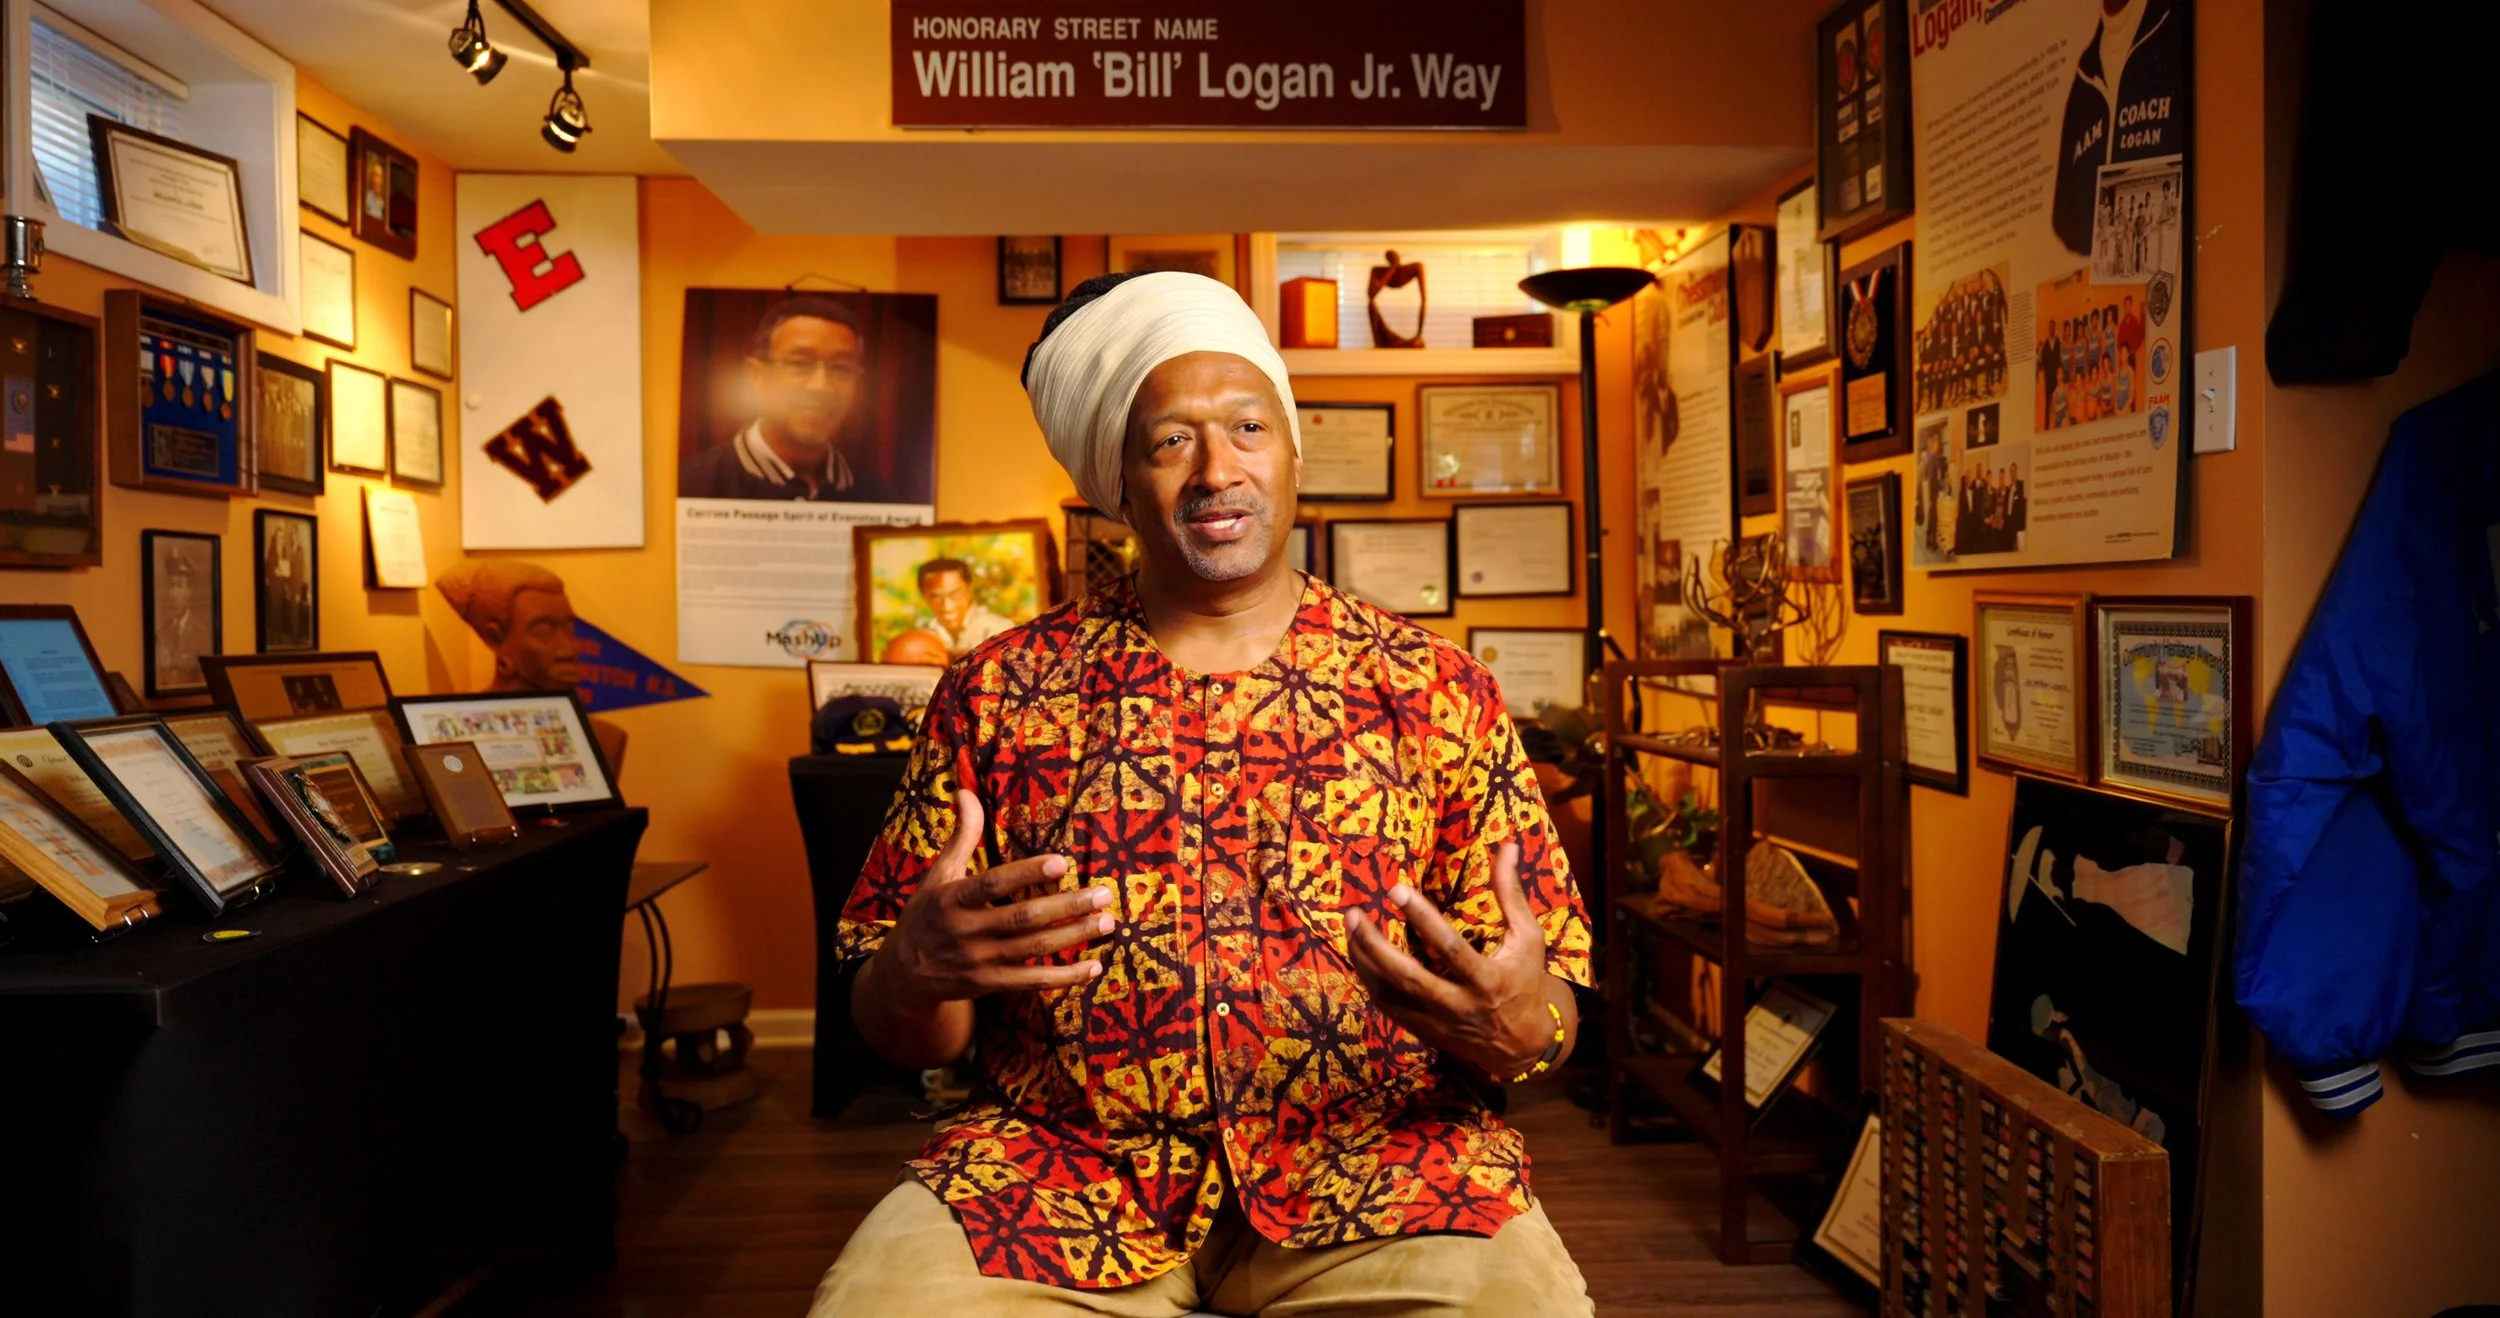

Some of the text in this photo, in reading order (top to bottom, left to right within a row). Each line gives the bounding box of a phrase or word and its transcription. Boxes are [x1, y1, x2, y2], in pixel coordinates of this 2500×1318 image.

[913, 17, 1218, 40] HONORARY STREET NAME
[912, 50, 1075, 98] William
[1199, 52, 1334, 110] Logan
[1351, 53, 1401, 99] Jr.
[1411, 53, 1502, 111] Way
[2119, 97, 2171, 128] COACH
[2120, 128, 2161, 149] LOGAN
[473, 198, 585, 313] E
[481, 394, 593, 505] W
[783, 510, 815, 523] Spirit
[766, 629, 842, 649] MashUp
